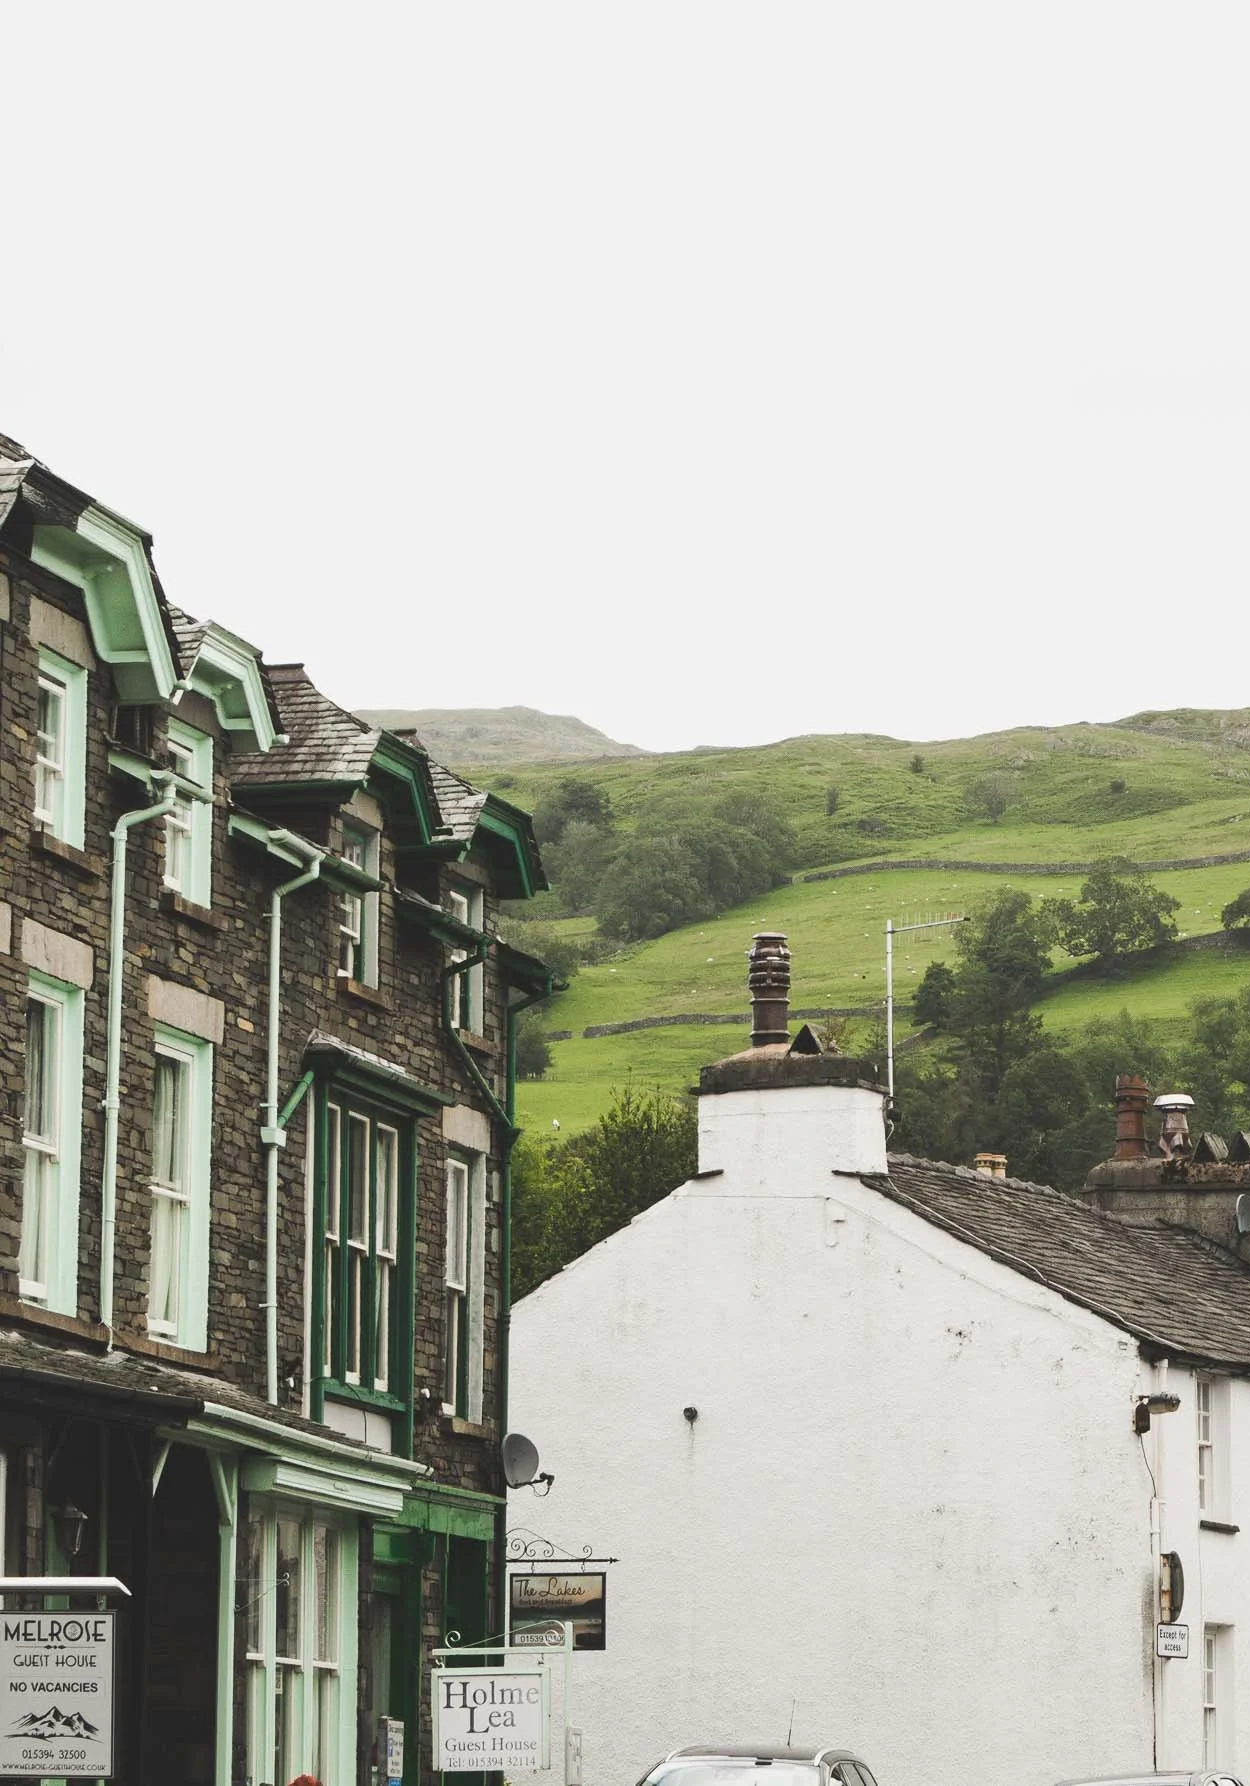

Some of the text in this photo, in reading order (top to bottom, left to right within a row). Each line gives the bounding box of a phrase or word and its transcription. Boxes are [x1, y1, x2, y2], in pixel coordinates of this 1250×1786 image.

[515, 1577, 585, 1597] The Lakes
[4, 1620, 106, 1642] MELROSE
[1160, 1629, 1186, 1640] Except for
[1164, 1643, 1181, 1651] access
[13, 1655, 97, 1667] GUEST HOUSE
[10, 1682, 98, 1692] NO VACANCIES
[442, 1680, 539, 1709] Holme
[466, 1707, 516, 1733] Lea
[445, 1737, 537, 1752] Guest House
[22, 1749, 86, 1759] 015394 32500
[448, 1757, 536, 1767] Tel: 015394 32114
